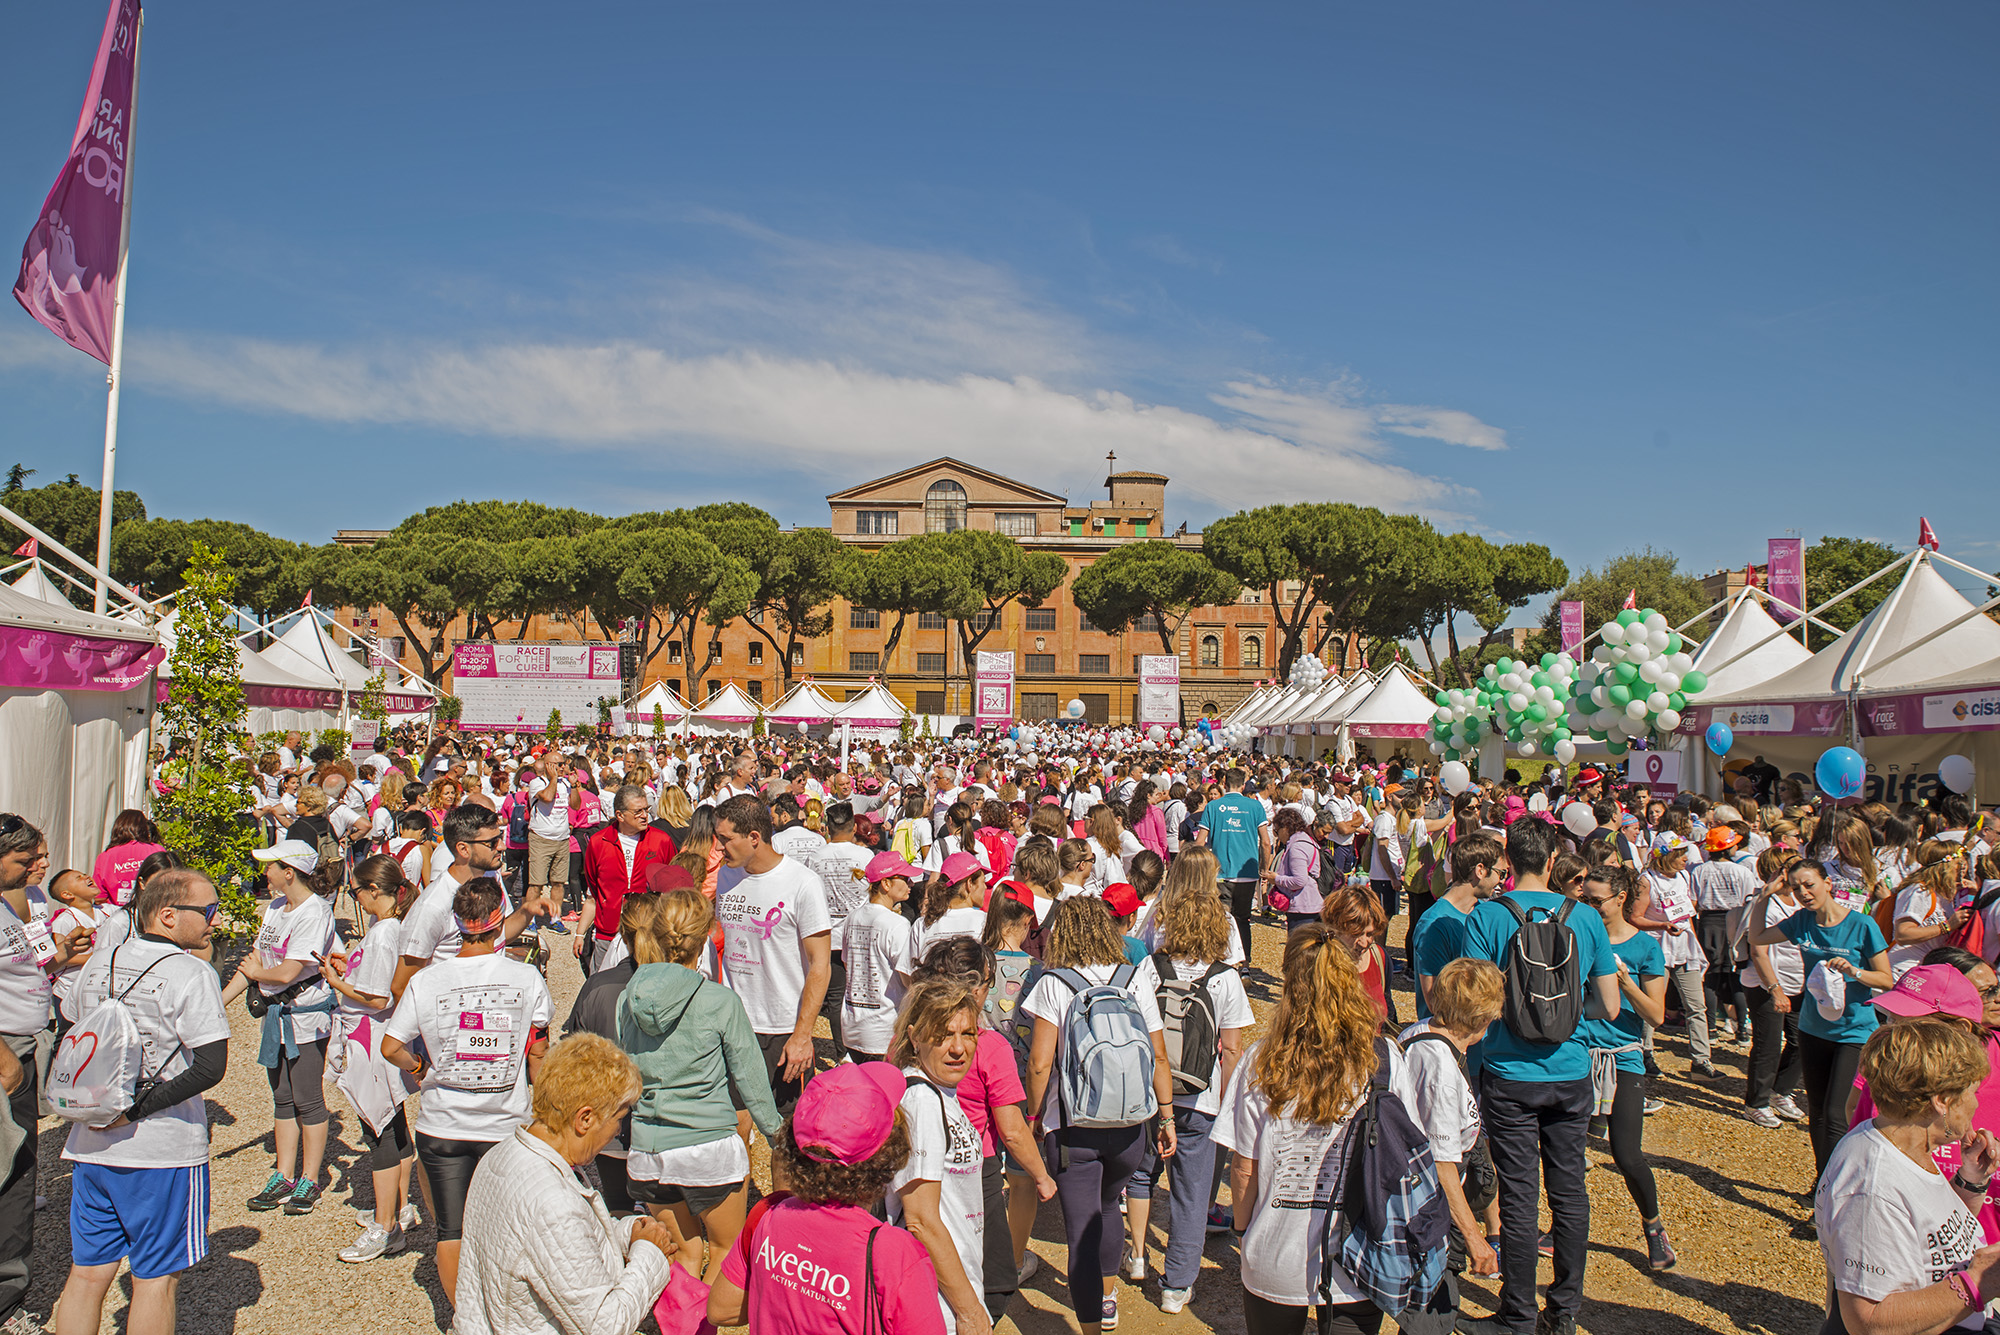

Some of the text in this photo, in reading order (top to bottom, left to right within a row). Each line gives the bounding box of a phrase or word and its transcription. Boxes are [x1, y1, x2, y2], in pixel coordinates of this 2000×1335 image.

[517, 647, 545, 655] RACE
[499, 655, 520, 663] FOR
[396, 697, 415, 710] ITALIA
[1971, 701, 2000, 716] cisa
[1740, 713, 1769, 724] cisalfa
[1876, 712, 1894, 723] race
[726, 895, 746, 903] BOLD
[723, 904, 761, 915] FEARLESS
[722, 913, 743, 922] MORE
[748, 926, 763, 935] CURE
[1902, 976, 1922, 987] race
[1905, 983, 1921, 993] cure
[470, 1036, 498, 1047] 9931
[953, 1151, 971, 1163] BE
[949, 1165, 978, 1175] RACE
[755, 1236, 850, 1297] Aveeno
[1845, 1258, 1885, 1276] OYSHO
[771, 1273, 842, 1310] ACTIVE NATURALS
